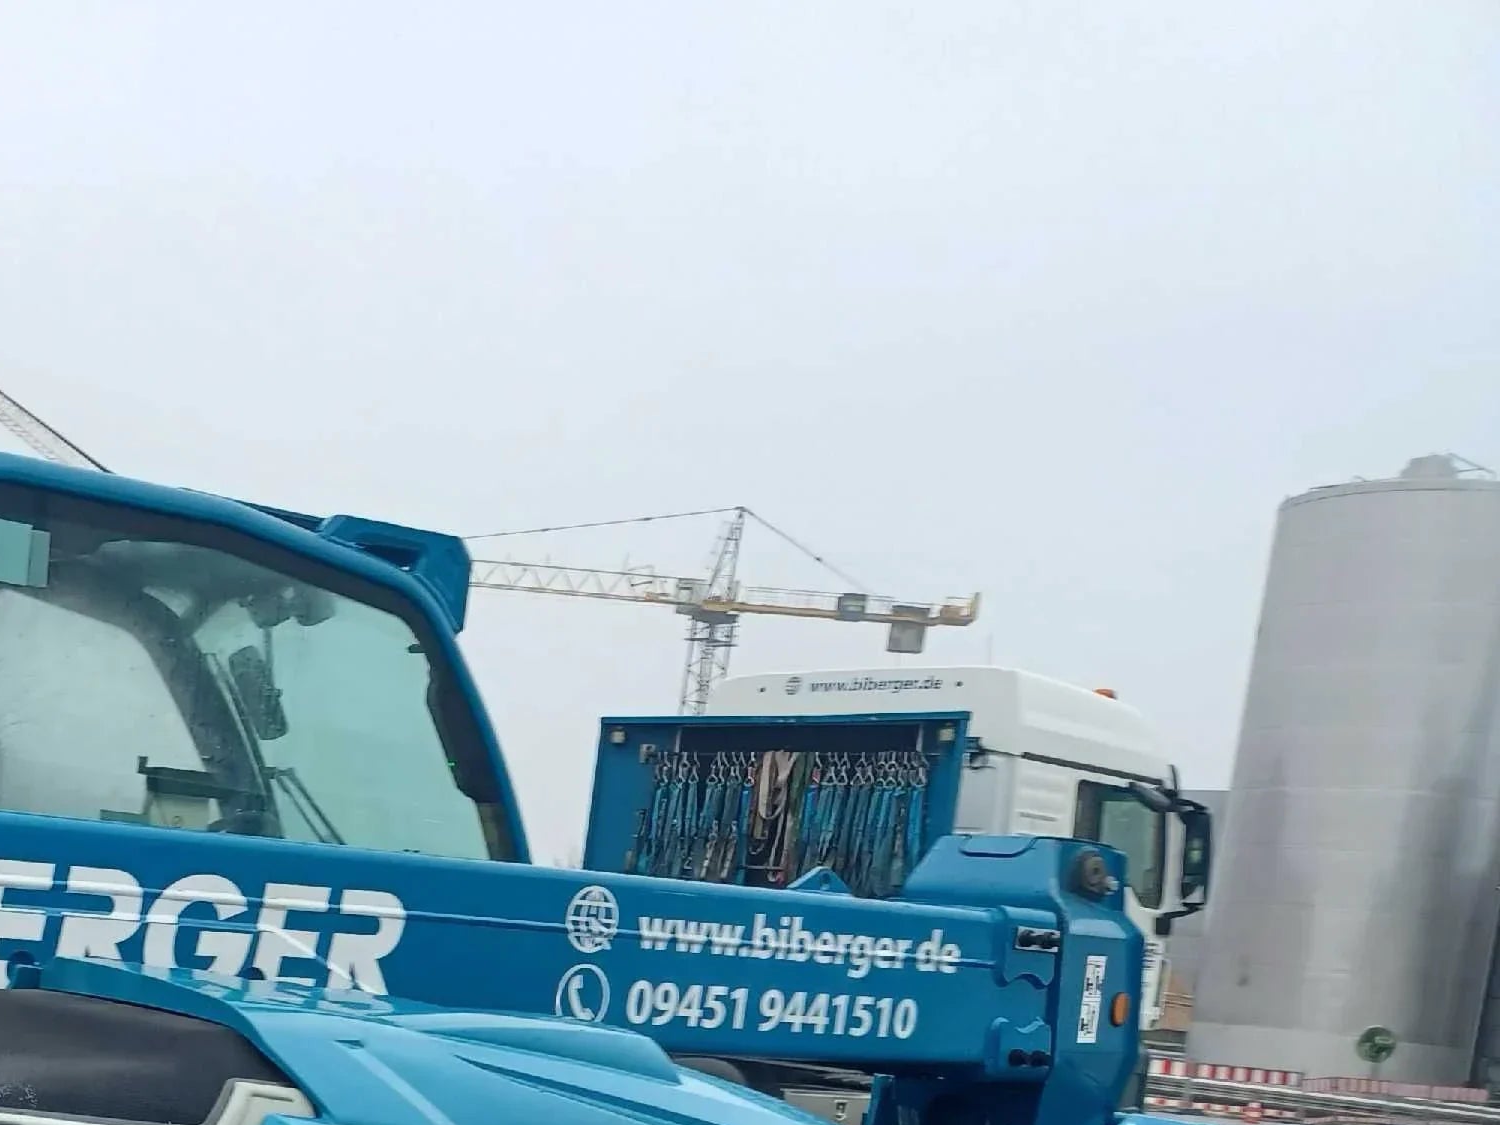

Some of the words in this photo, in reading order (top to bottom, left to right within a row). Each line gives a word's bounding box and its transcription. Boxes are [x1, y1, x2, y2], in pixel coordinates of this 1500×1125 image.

[810, 676, 943, 693] www.biberger.de
[626, 980, 749, 1029] 09451
[758, 989, 918, 1039] 9441510
